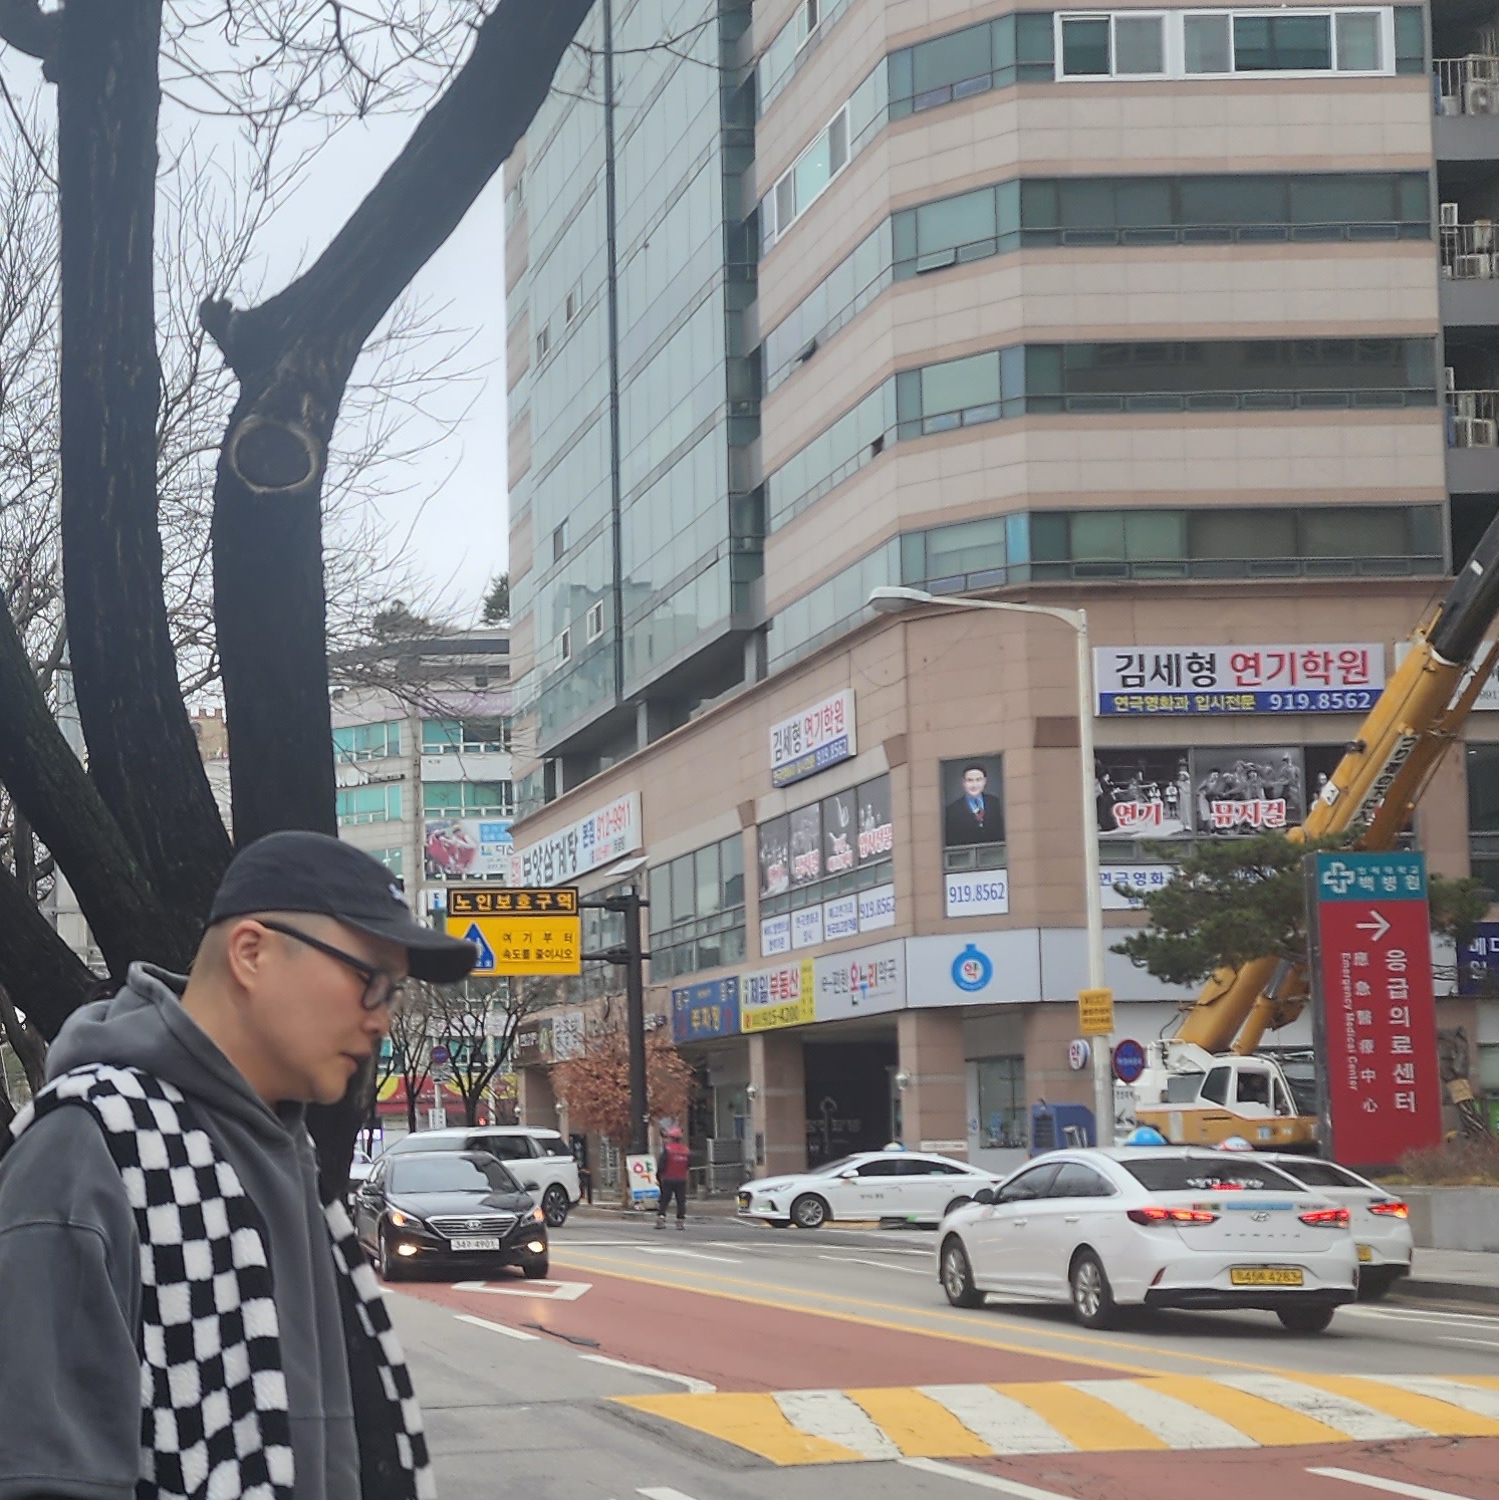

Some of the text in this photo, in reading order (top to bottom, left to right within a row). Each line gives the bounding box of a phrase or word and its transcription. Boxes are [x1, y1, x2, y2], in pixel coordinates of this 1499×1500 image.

[1115, 648, 1371, 688] 김세형 연기학원
[1113, 692, 1371, 712] 연극영화과 입시전문 919.8562
[773, 699, 845, 762] 김세형 연기학원
[1114, 802, 1163, 827] 연기
[1213, 800, 1285, 827] 뮤지컬
[949, 882, 1005, 903] 919.8562
[1358, 875, 1421, 892] 백병원
[454, 893, 573, 911] 노인보호구역
[502, 948, 573, 960] 속도를 줄이시오
[1341, 953, 1358, 1091] Emergency Medical Center
[1385, 949, 1416, 1113] 응급의료센터
